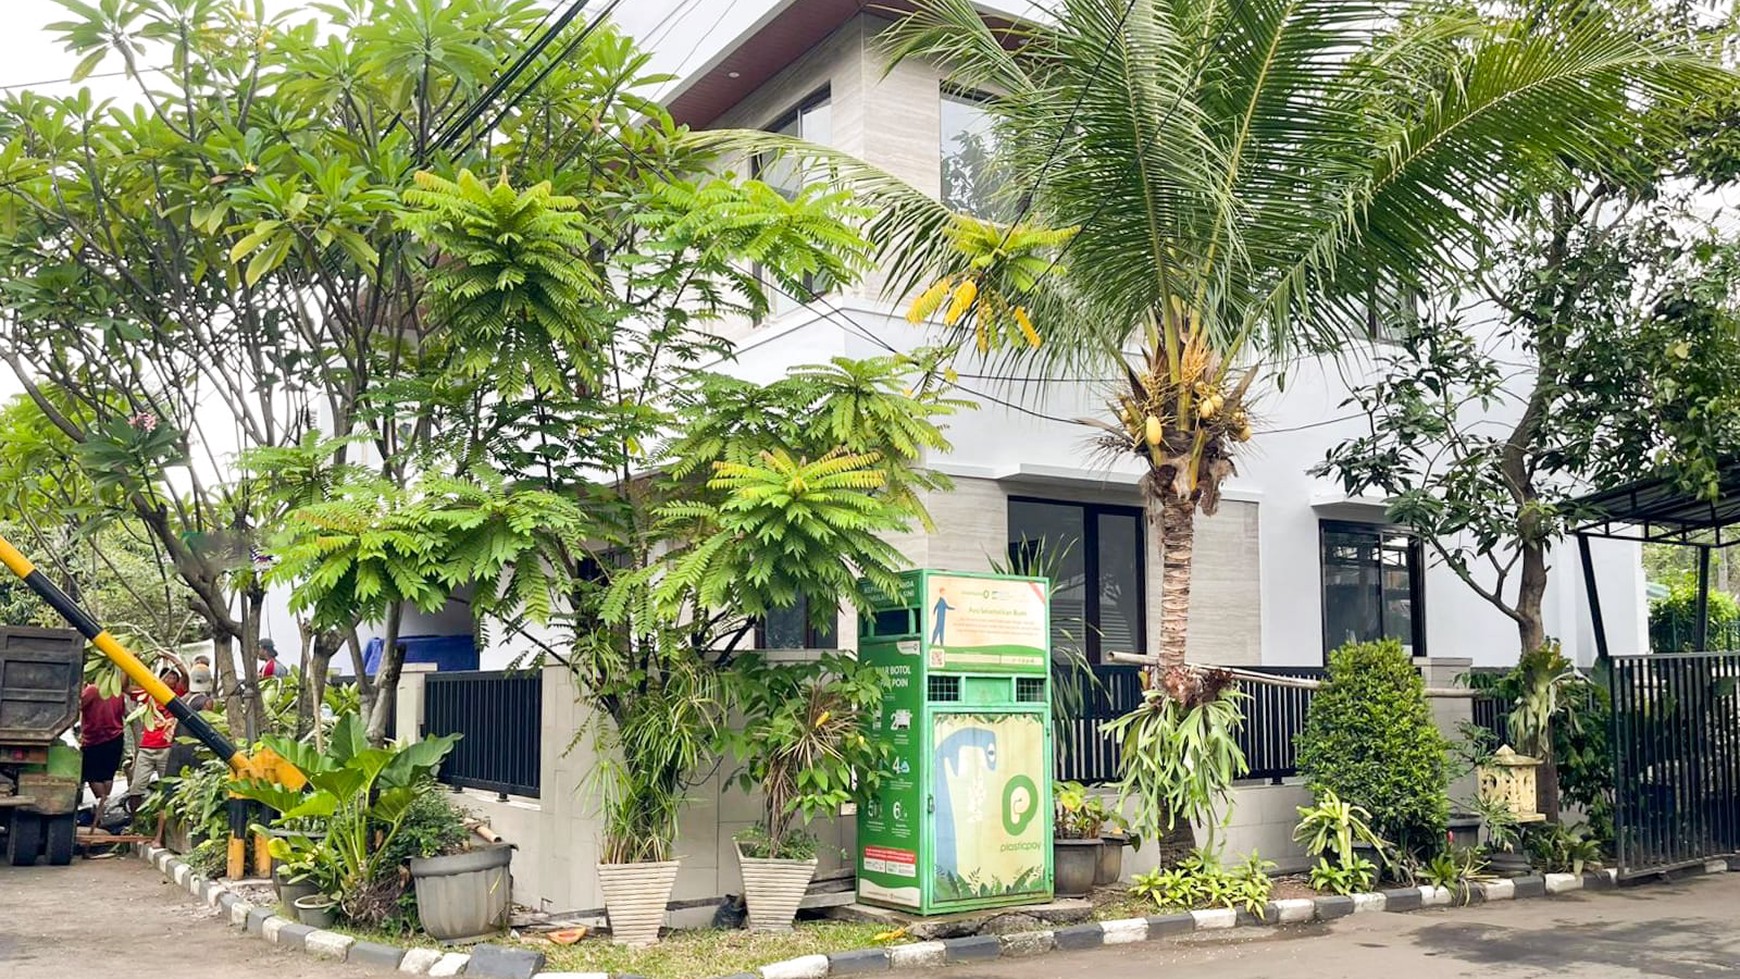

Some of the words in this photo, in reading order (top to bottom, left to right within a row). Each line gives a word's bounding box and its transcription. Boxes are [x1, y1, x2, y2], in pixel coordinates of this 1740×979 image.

[890, 665, 911, 675] BOTOL
[892, 678, 909, 687] POIN
[892, 756, 901, 775] 4
[892, 801, 901, 820] 6
[1000, 840, 1042, 853] plasticpay
